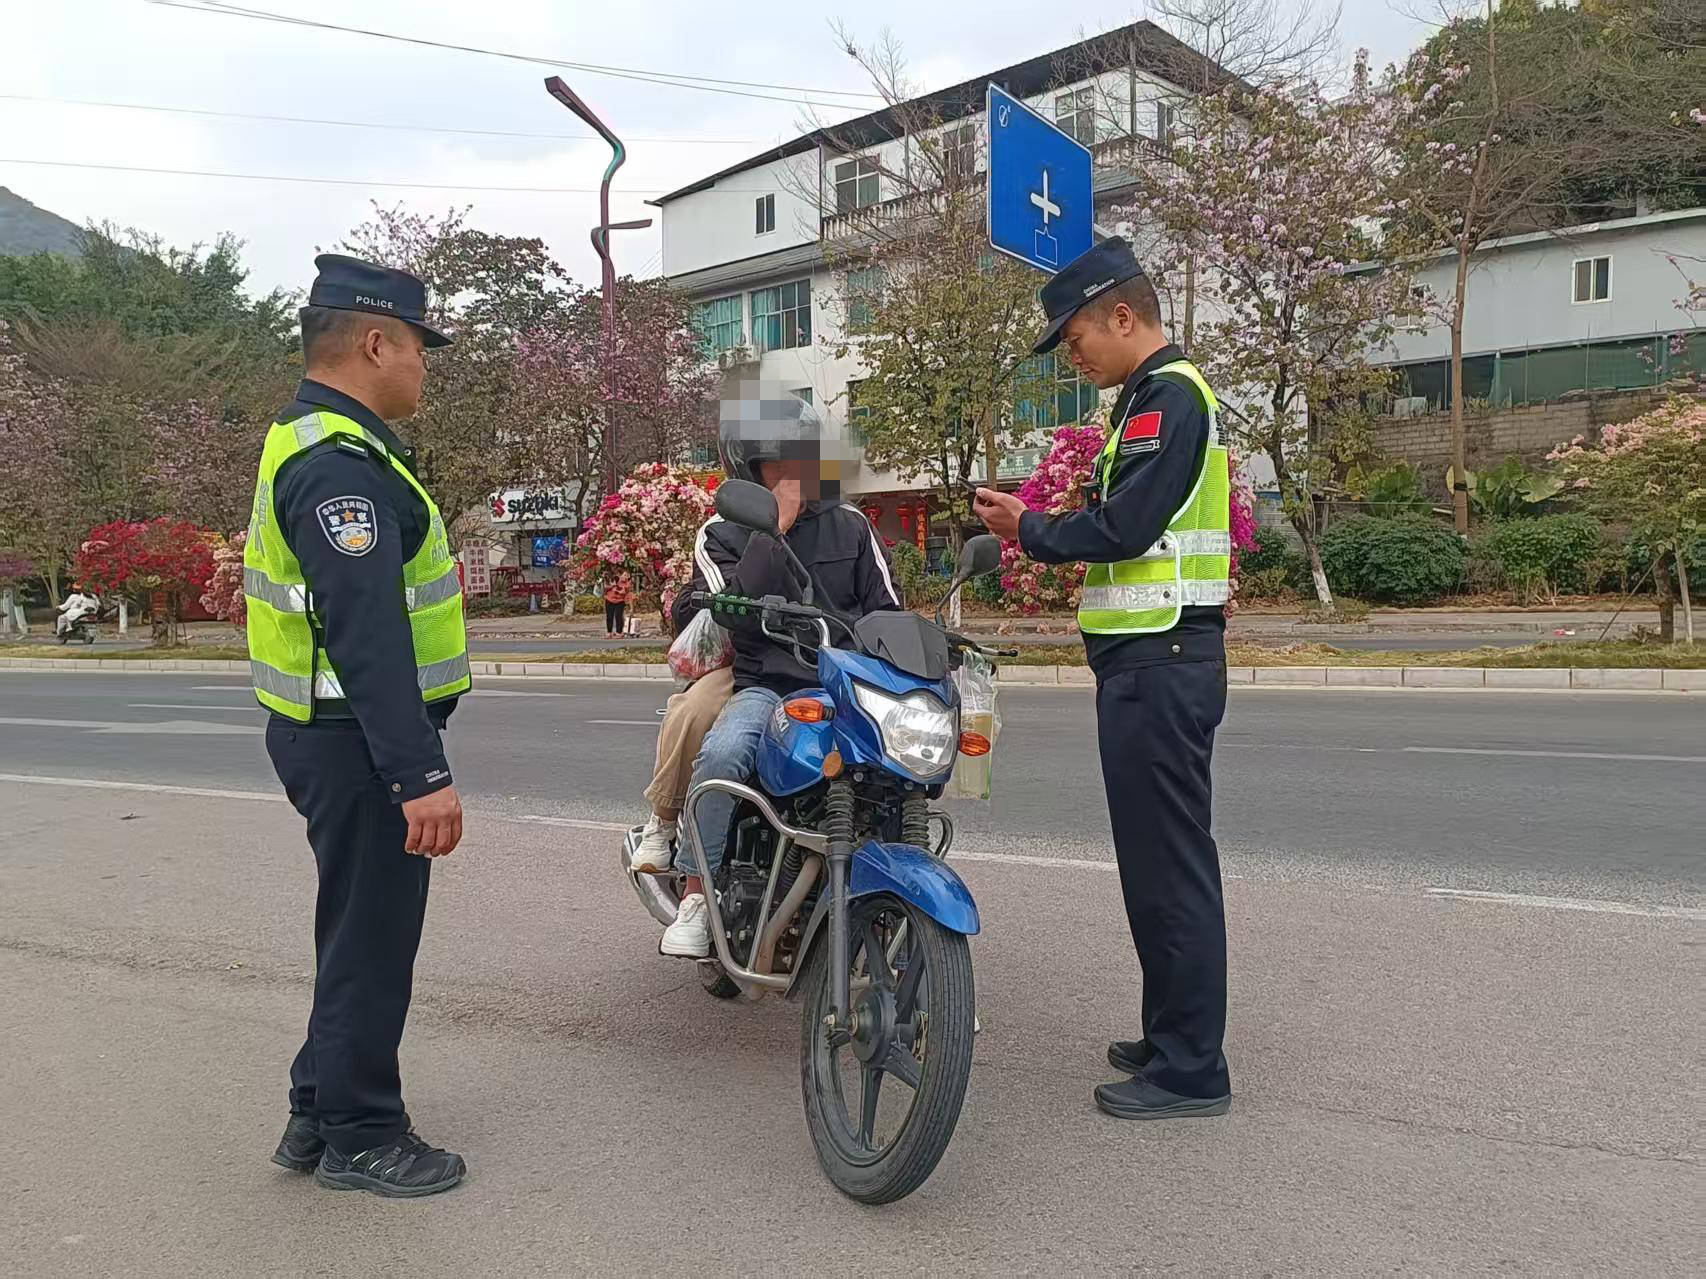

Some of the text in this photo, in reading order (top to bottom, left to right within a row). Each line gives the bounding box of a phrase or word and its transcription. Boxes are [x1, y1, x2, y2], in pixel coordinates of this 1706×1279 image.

[355, 295, 394, 309] POLICE
[322, 500, 369, 516] 中华人民共和国
